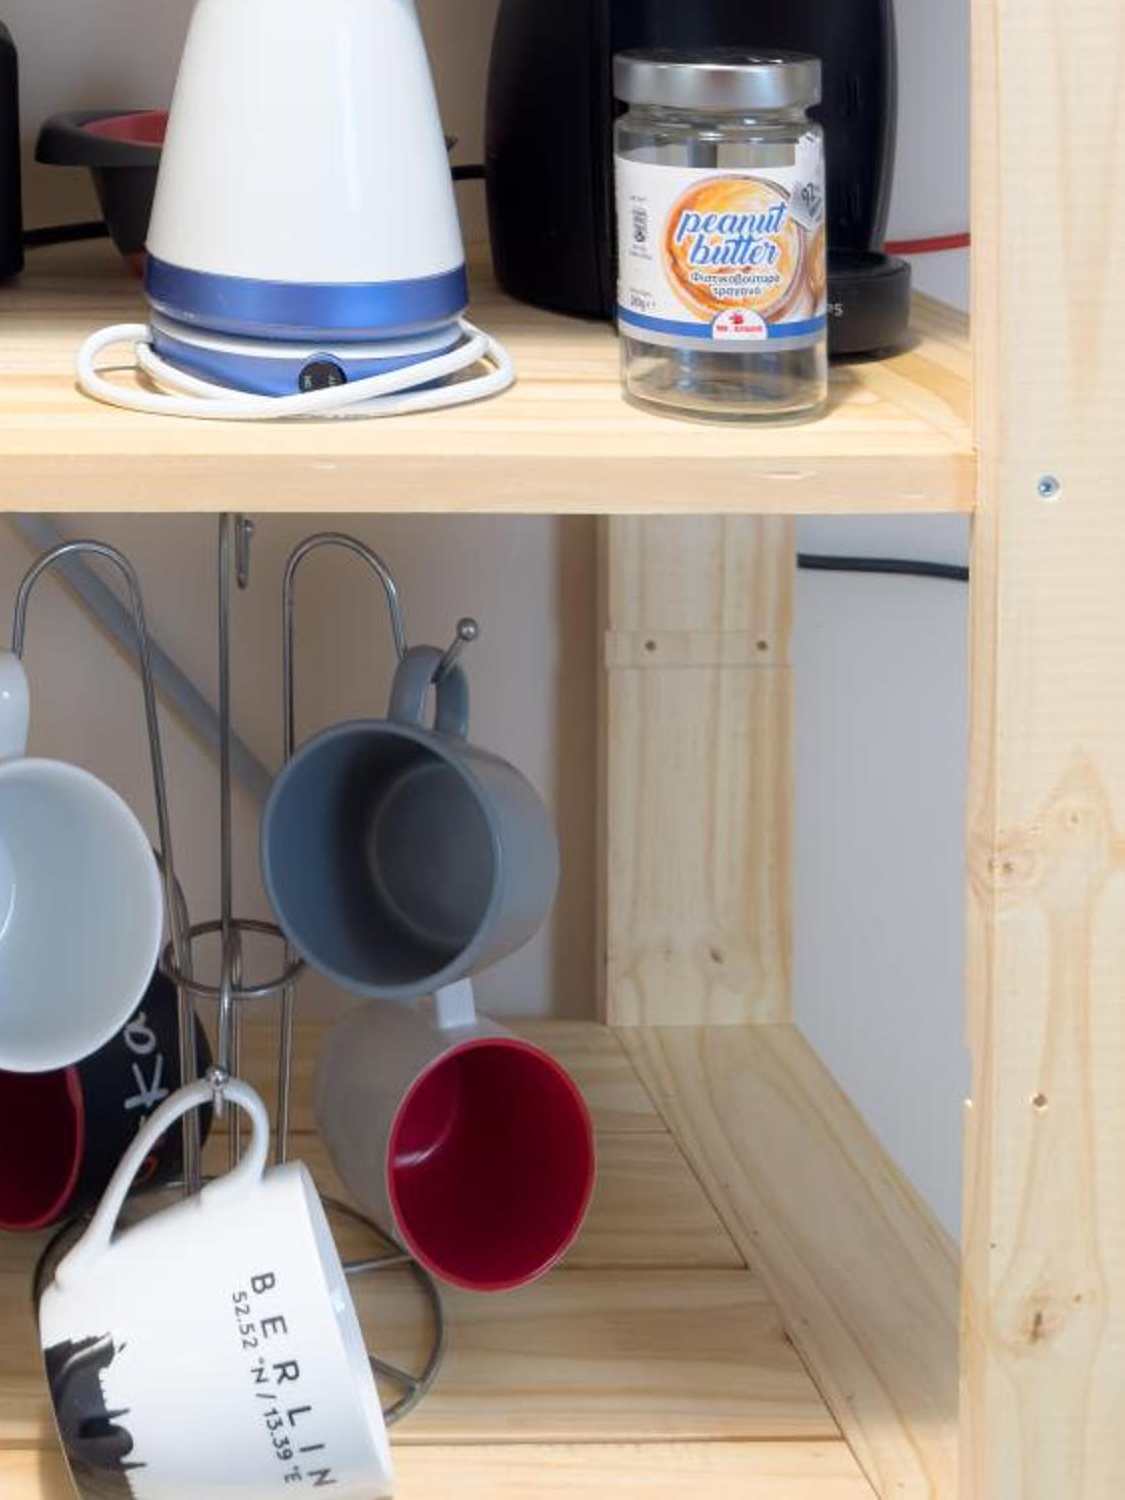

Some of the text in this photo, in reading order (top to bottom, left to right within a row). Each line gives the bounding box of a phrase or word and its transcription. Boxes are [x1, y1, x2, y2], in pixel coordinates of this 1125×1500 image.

[676, 202, 787, 242] peanut
[690, 233, 777, 265] butter
[232, 1290, 259, 1351] 52.52
[263, 1407, 294, 1462] 13.39
[250, 1271, 338, 1488] BERLIN
